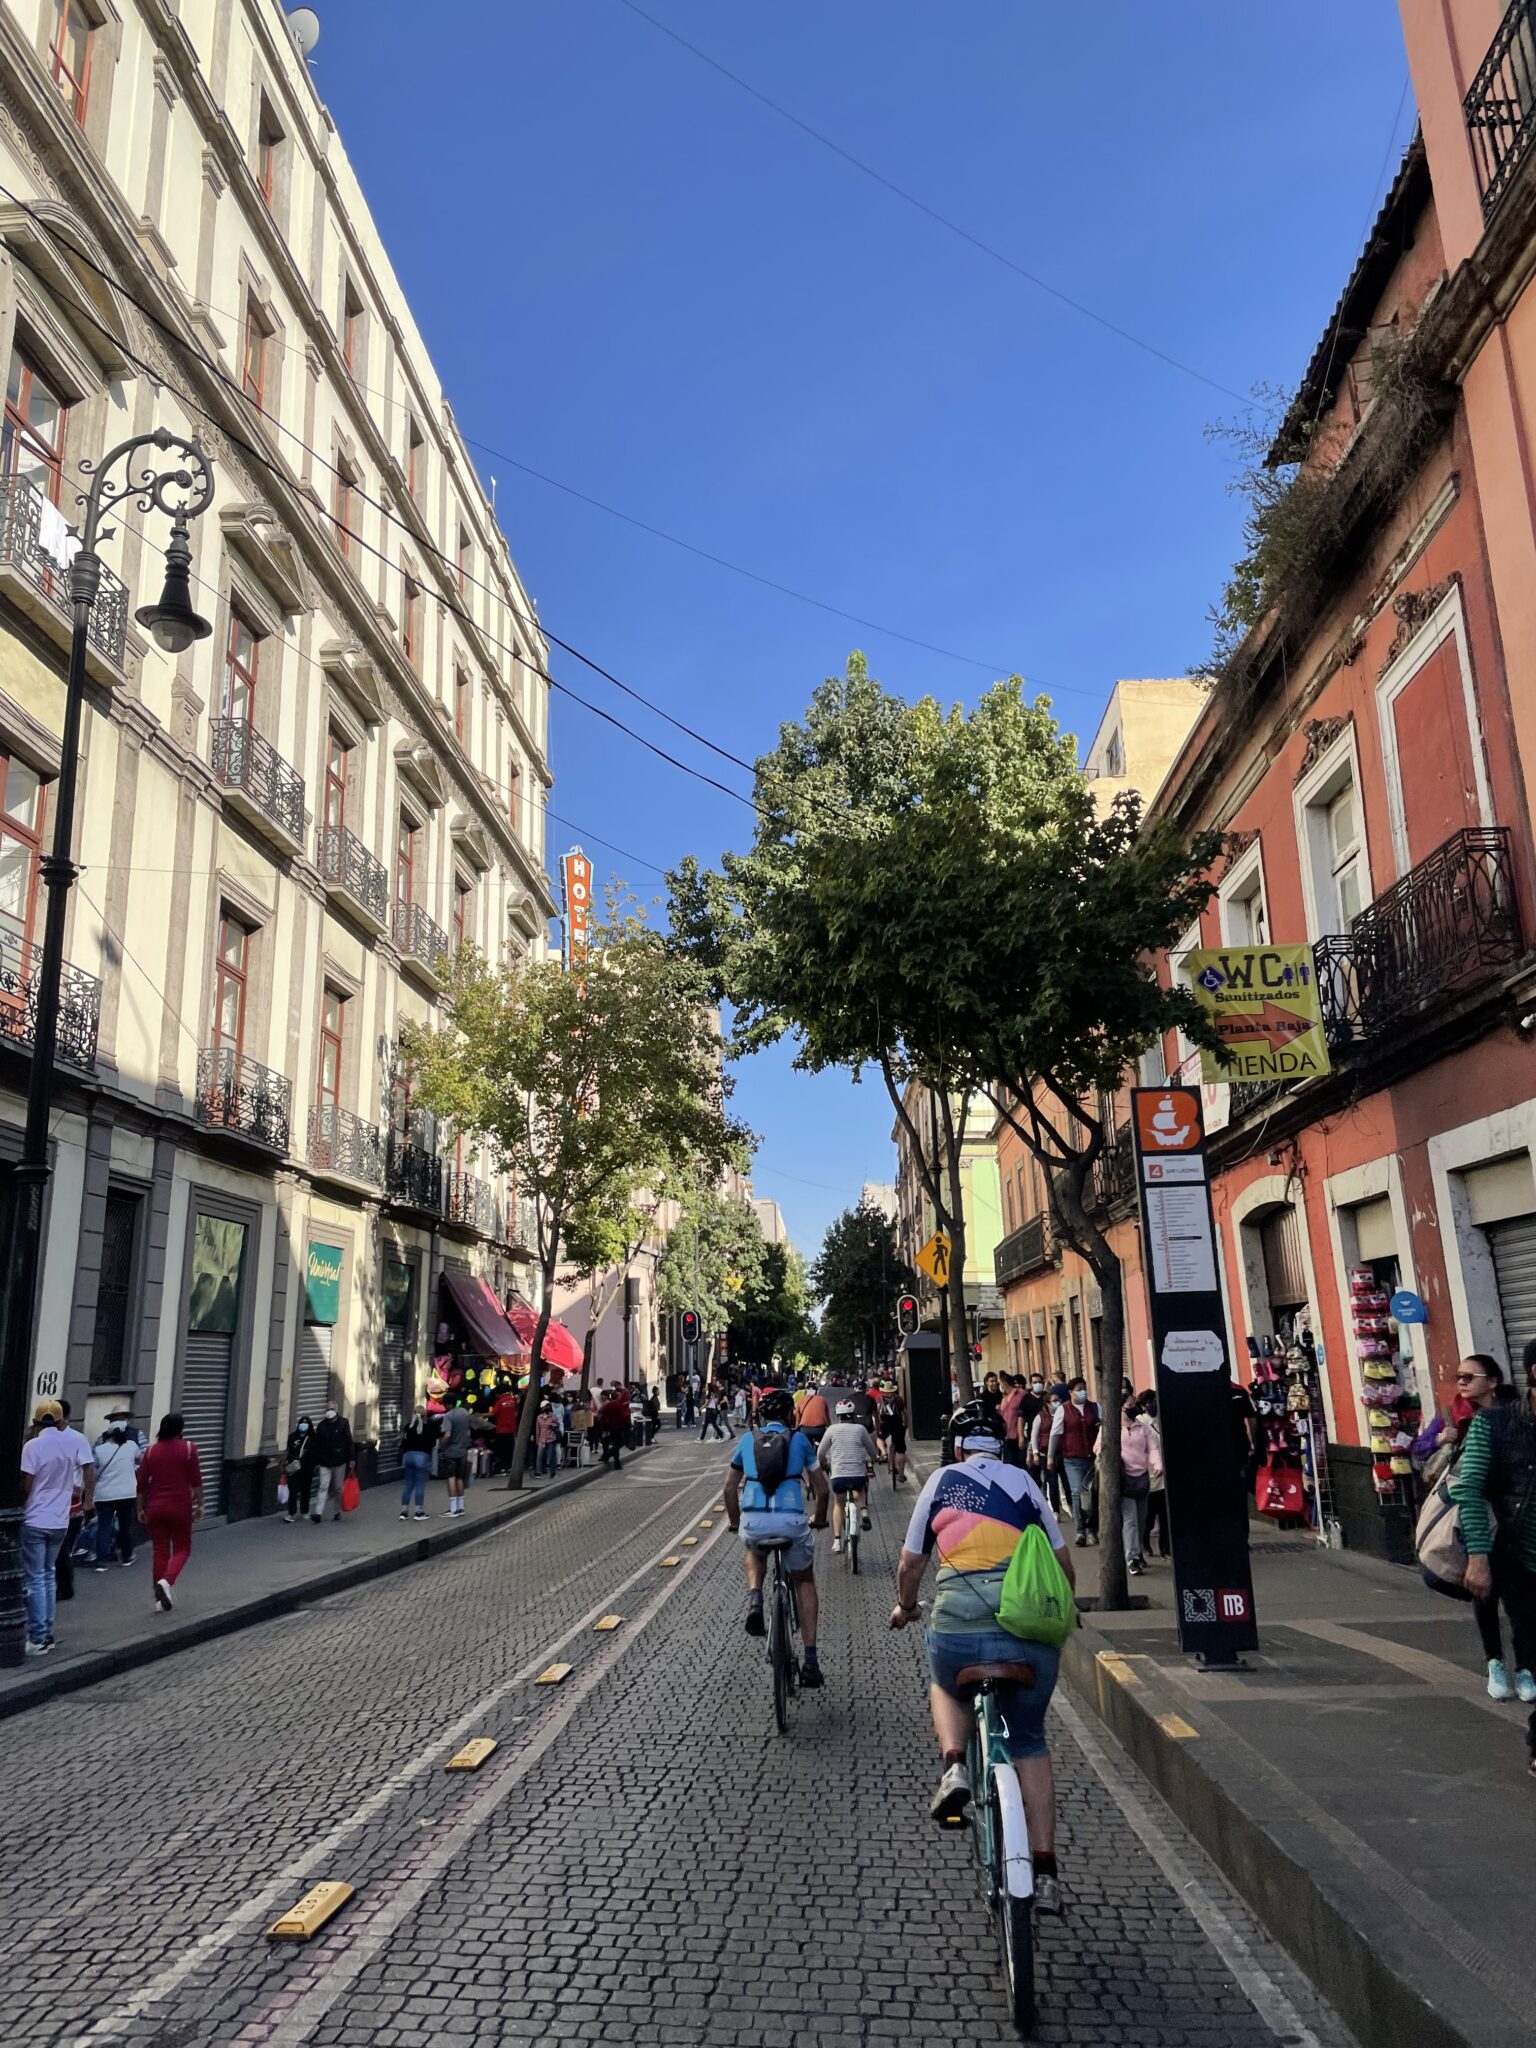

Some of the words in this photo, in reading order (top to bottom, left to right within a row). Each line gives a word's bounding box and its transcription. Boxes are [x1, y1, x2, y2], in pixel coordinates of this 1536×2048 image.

[1219, 953, 1284, 989] WC
[1215, 990, 1300, 1003] Sanitizados
[1218, 1021, 1271, 1036] Planta
[1275, 1020, 1312, 1035] Baja
[1151, 1166, 1162, 1177] 4
[36, 1370, 58, 1397] 68
[1223, 1594, 1245, 1617] MB
